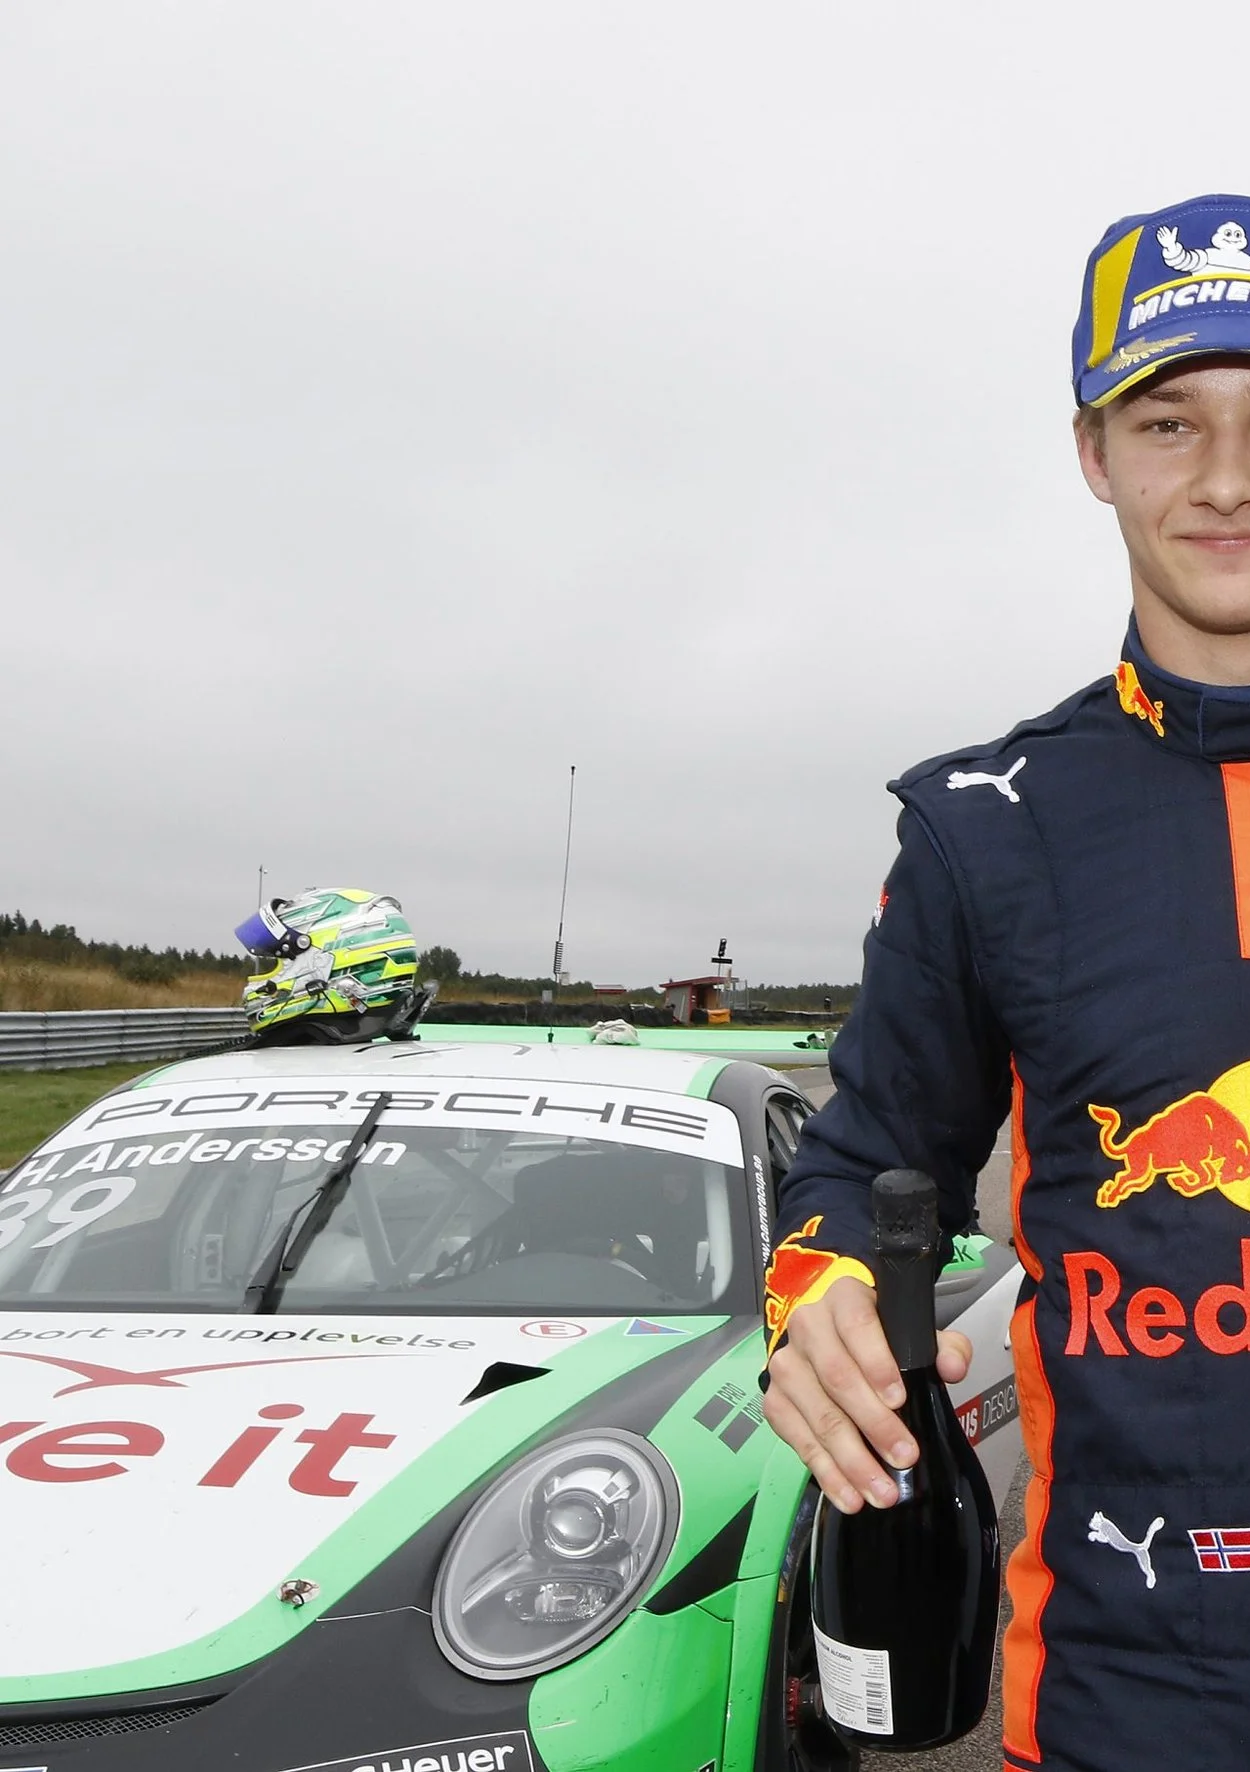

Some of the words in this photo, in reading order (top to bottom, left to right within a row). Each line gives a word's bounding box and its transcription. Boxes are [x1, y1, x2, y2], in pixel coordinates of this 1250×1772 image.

[84, 1090, 708, 1140] PORSCHE
[1, 1327, 115, 1341] bort
[125, 1328, 187, 1339] en
[202, 1328, 476, 1350] upplevelse
[197, 1403, 398, 1497] it
